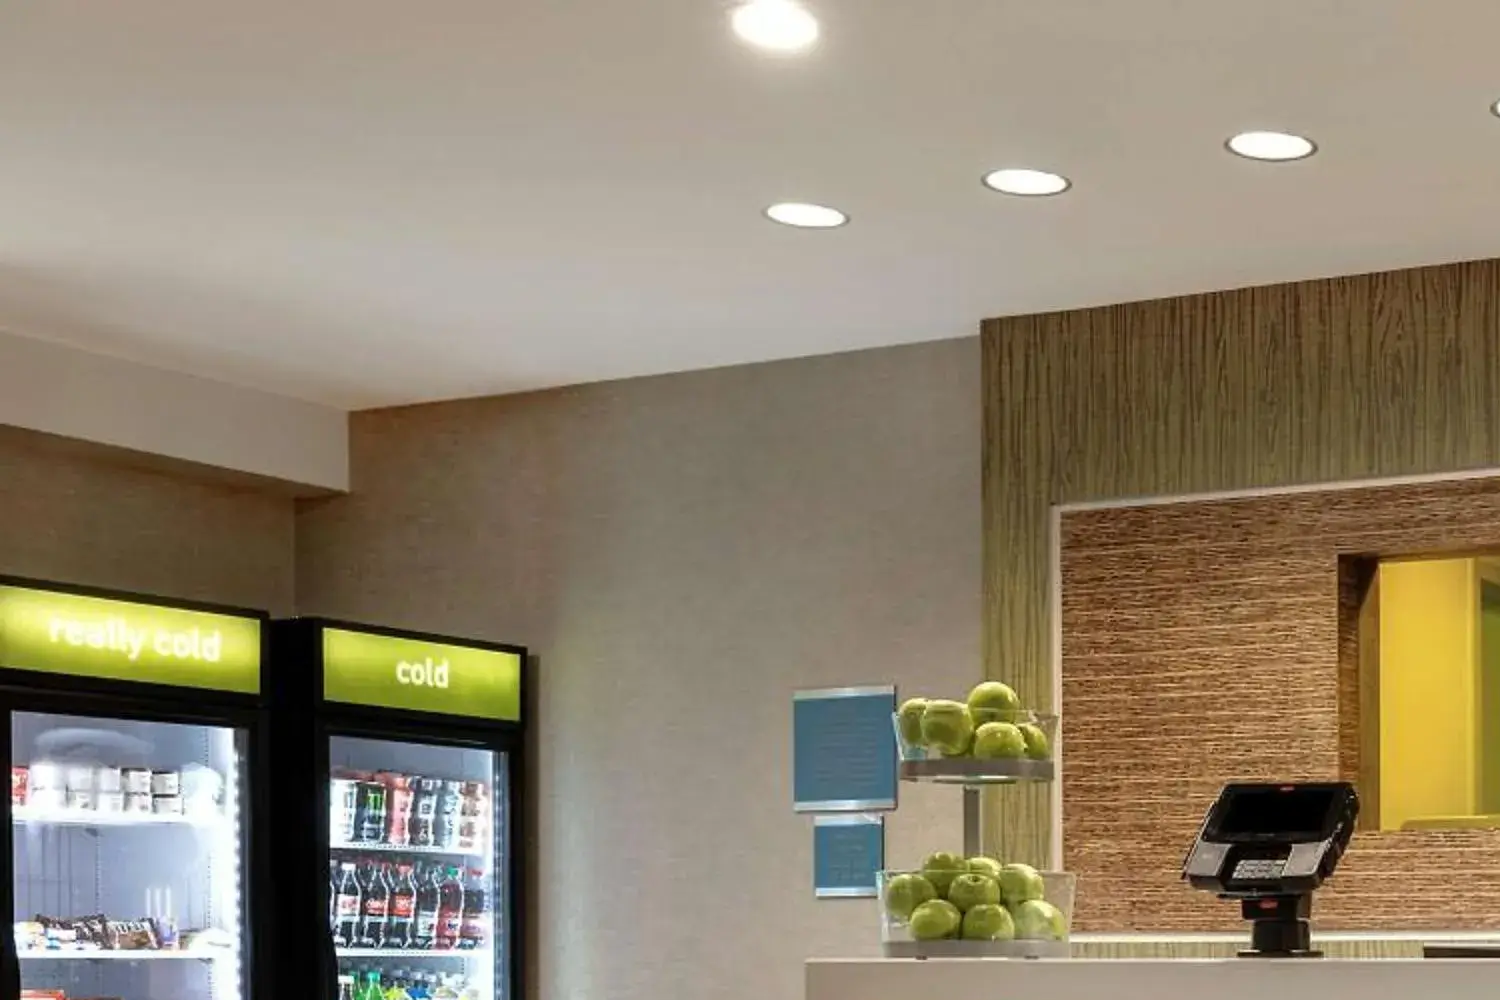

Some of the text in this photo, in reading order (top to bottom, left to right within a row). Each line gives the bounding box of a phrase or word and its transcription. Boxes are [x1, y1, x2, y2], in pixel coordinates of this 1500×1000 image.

[50, 618, 222, 663] really cold
[396, 656, 450, 689] cold
